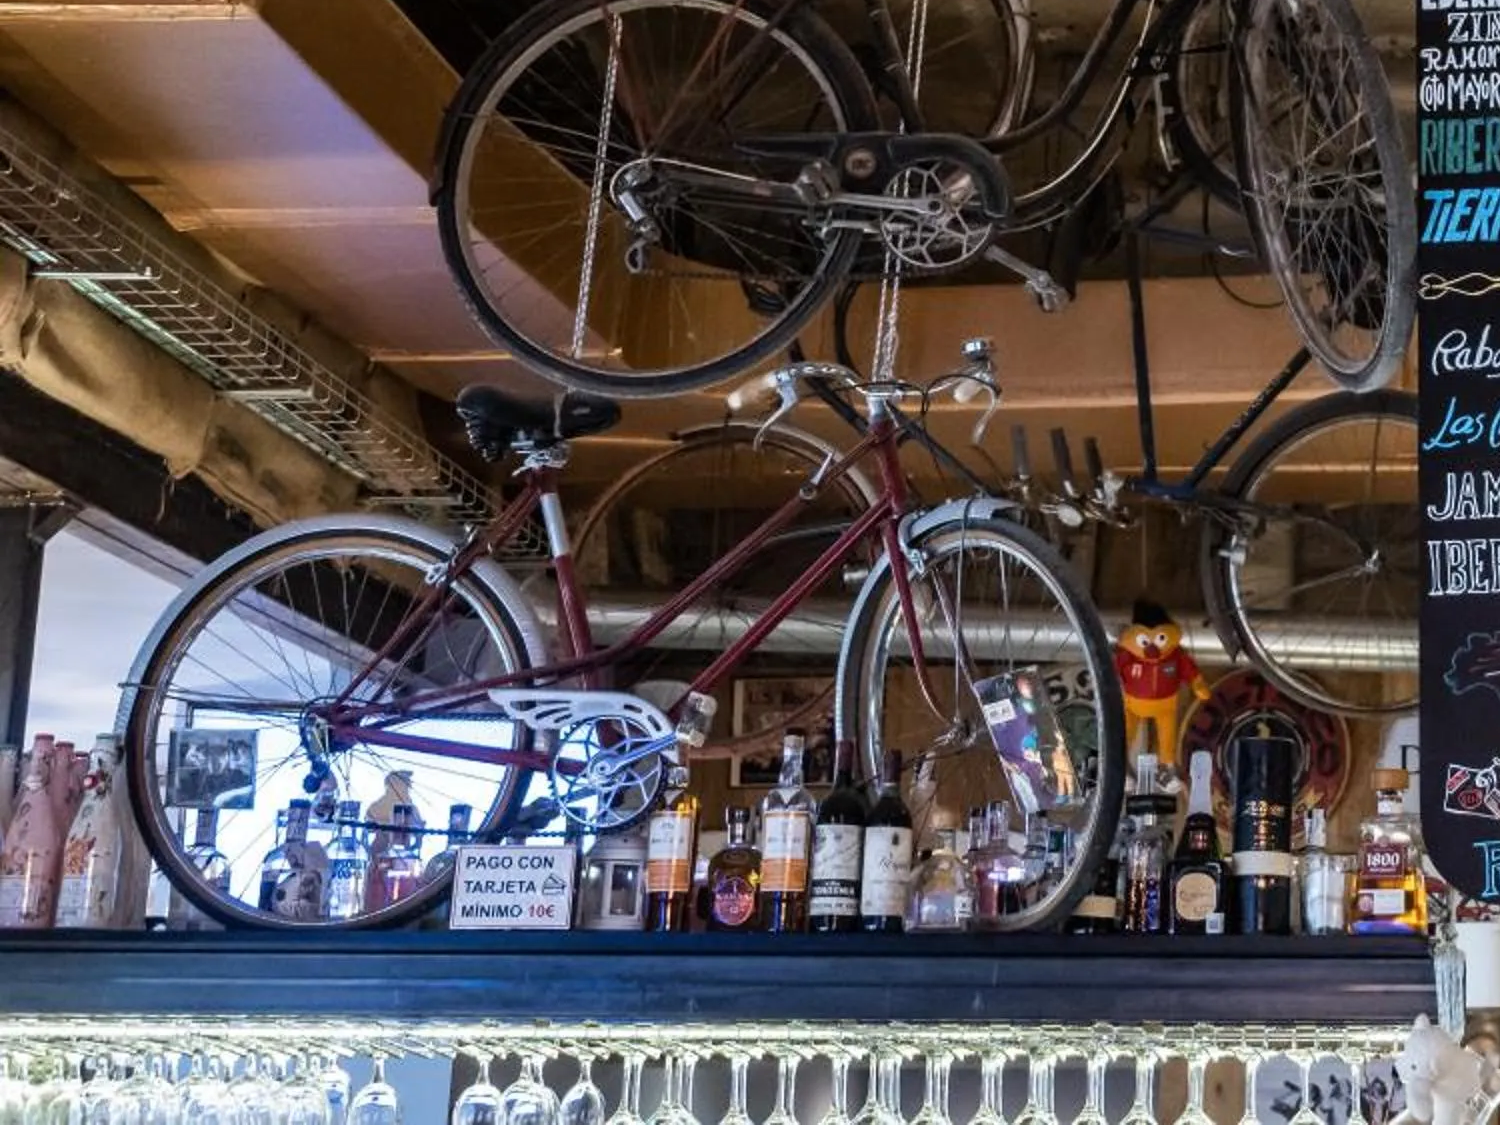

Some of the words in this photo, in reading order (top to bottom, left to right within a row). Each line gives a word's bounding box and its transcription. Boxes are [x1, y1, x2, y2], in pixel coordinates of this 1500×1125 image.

[465, 856, 513, 870] PAGO
[517, 856, 555, 870] CON
[1366, 851, 1401, 868] 1800
[464, 880, 537, 894] TARJETA
[527, 904, 556, 918] 10€
